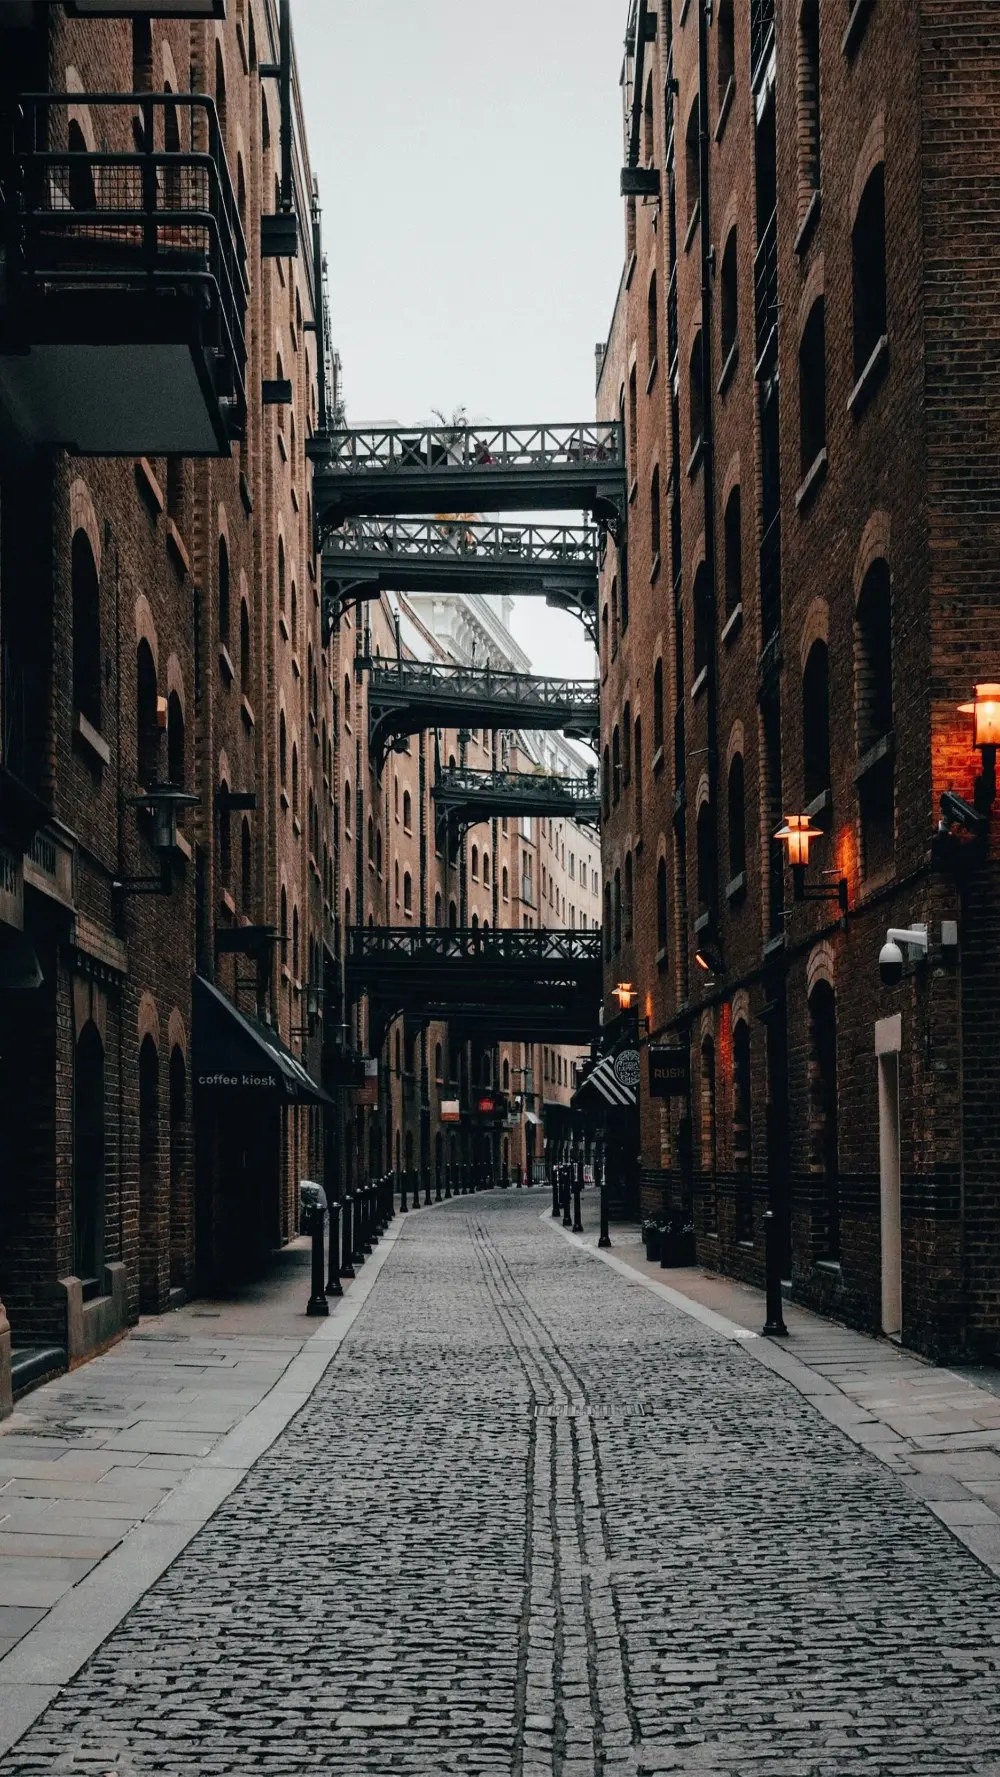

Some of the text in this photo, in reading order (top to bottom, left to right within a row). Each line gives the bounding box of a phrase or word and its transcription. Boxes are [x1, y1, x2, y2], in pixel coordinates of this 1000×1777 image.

[653, 1067, 685, 1079] RUSH
[198, 1074, 277, 1086] coffee kiosk
